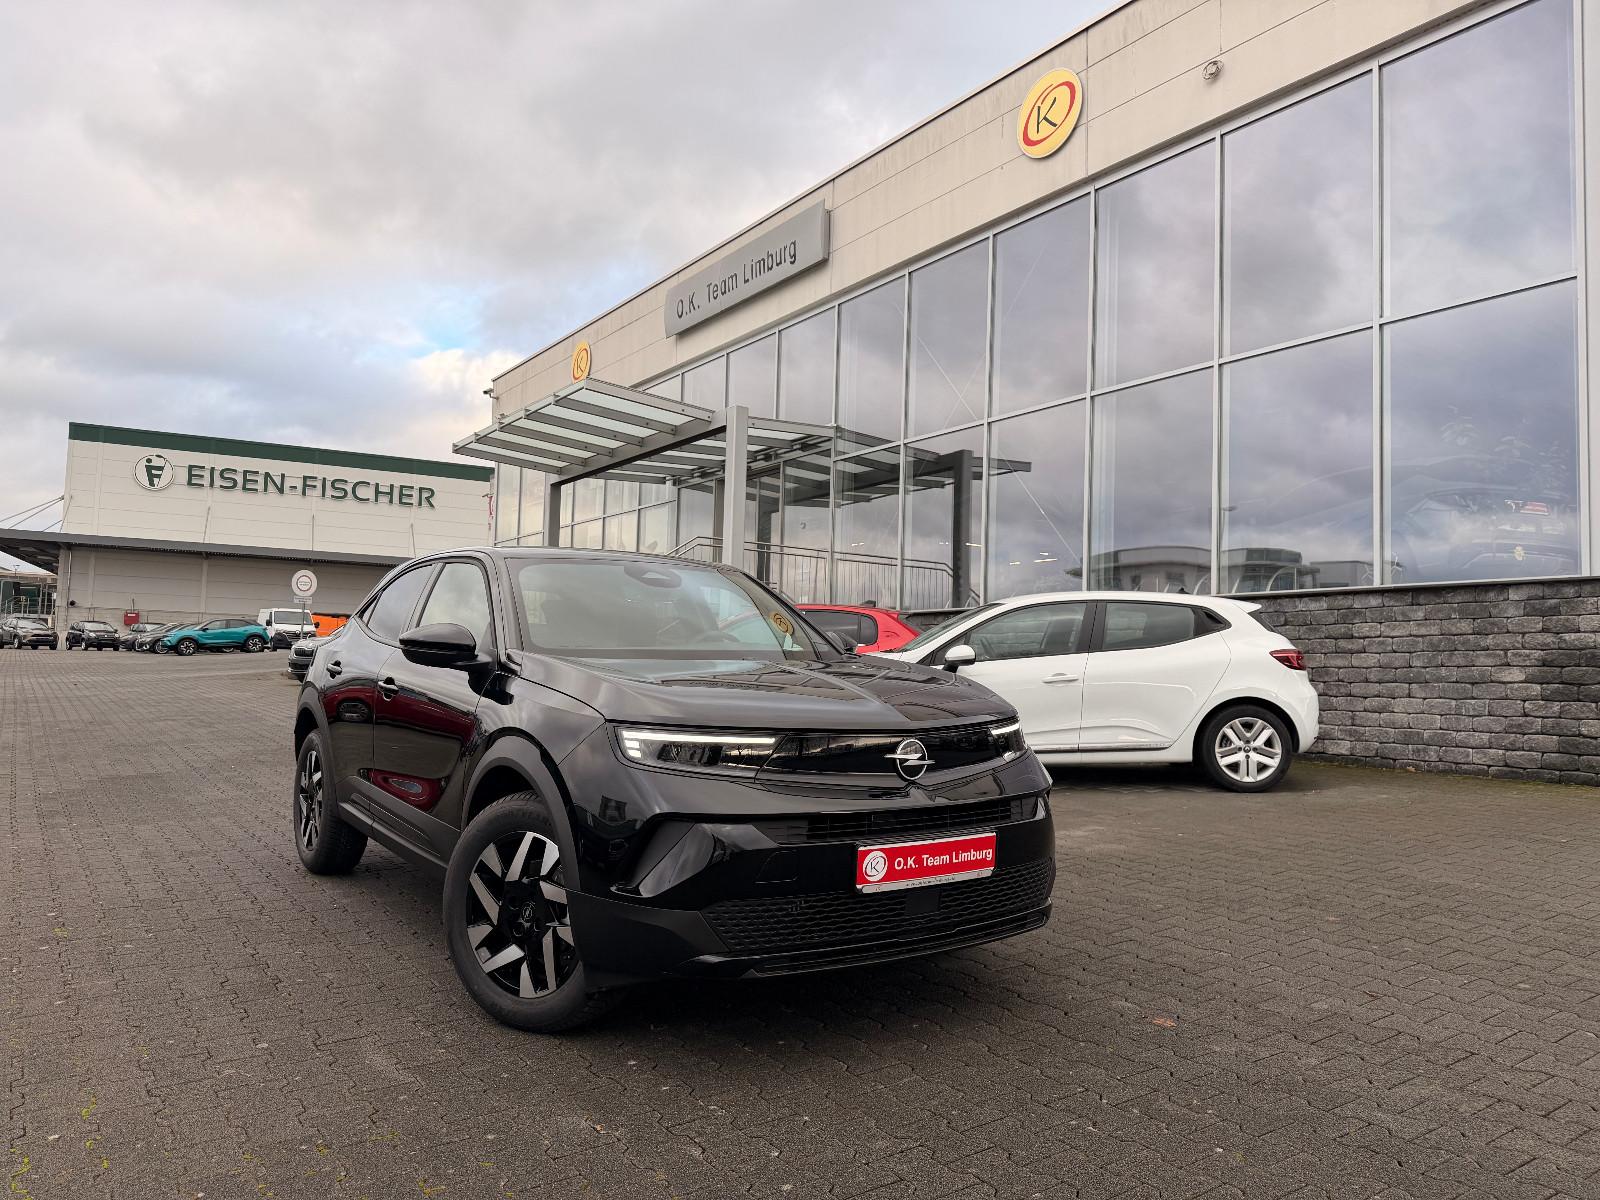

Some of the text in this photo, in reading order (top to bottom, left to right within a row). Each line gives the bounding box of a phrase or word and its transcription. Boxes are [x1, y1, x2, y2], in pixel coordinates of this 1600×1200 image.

[676, 239, 797, 319] O.K. Team Limburg
[186, 464, 436, 510] EISEN-FISCHER
[894, 848, 993, 870] O.K. Team Limburg
